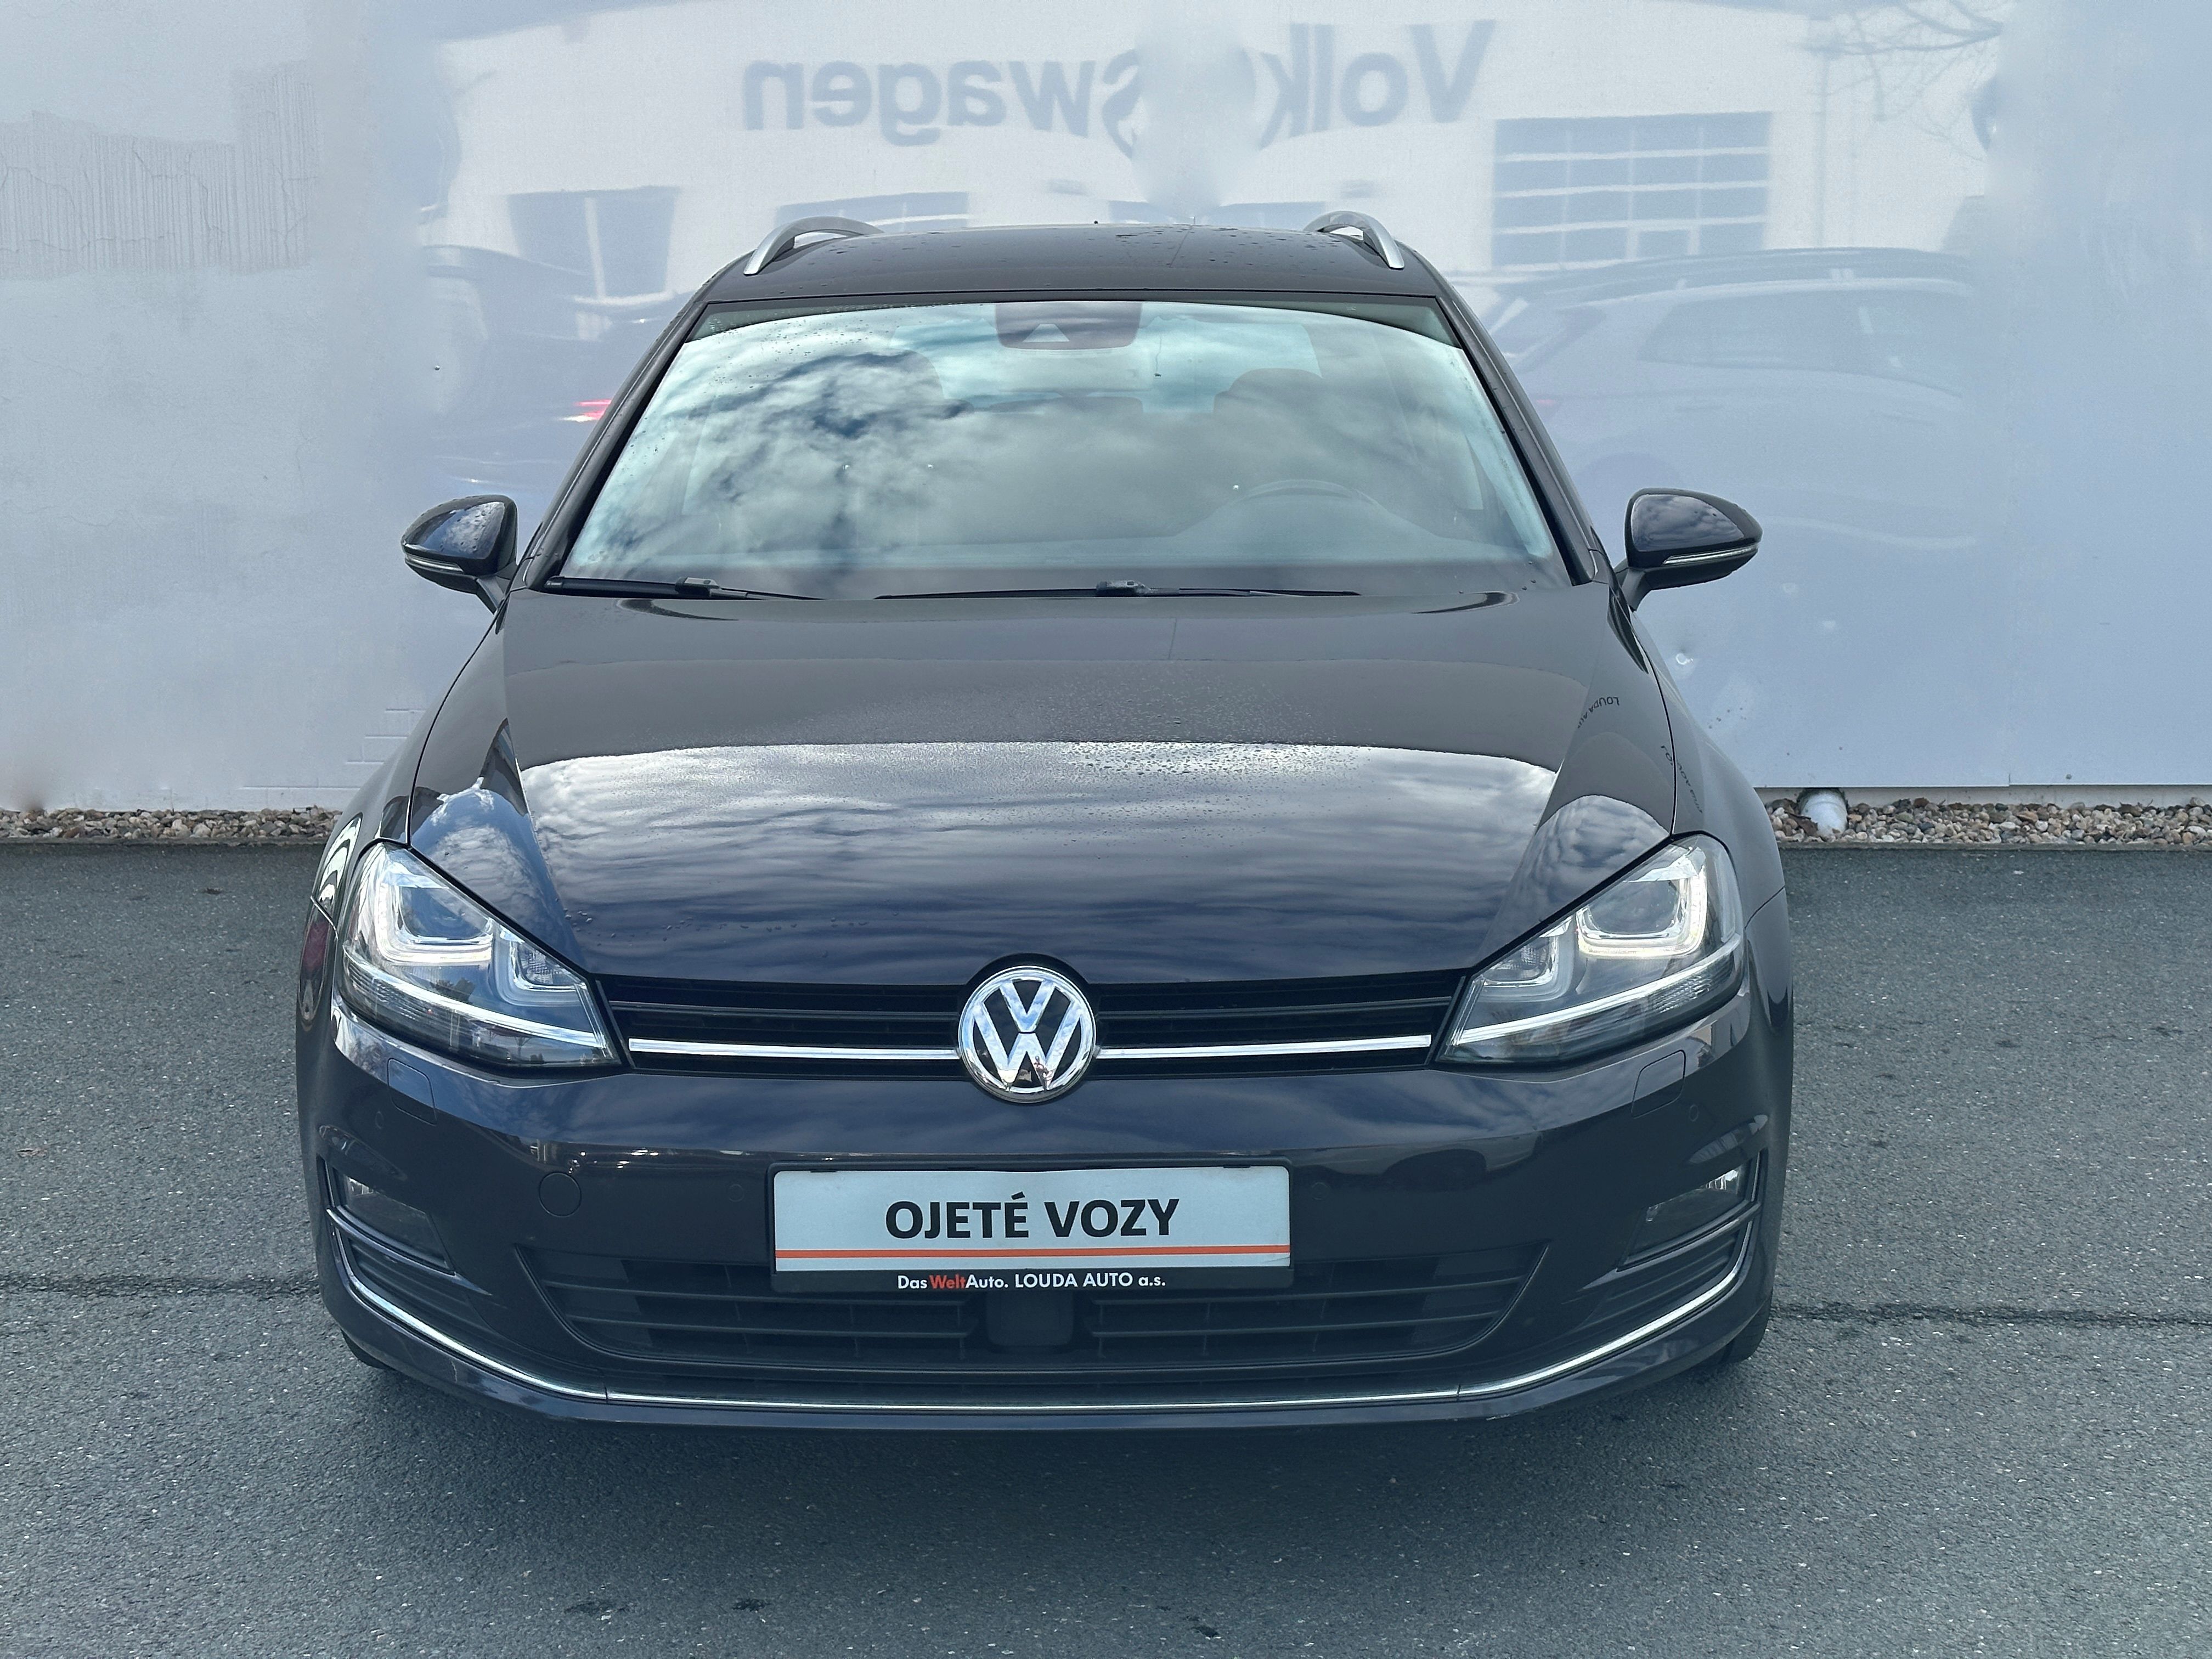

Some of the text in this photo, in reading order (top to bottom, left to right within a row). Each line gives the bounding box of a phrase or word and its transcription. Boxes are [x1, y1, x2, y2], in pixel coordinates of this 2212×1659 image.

[967, 974, 1088, 1096] VW
[885, 1191, 1180, 1239] OJETÉ VOZY
[897, 1275, 927, 1289] Das
[1014, 1273, 1078, 1288] LOUDA
[1082, 1272, 1133, 1287] AUTO
[1138, 1276, 1166, 1286] a.s.
